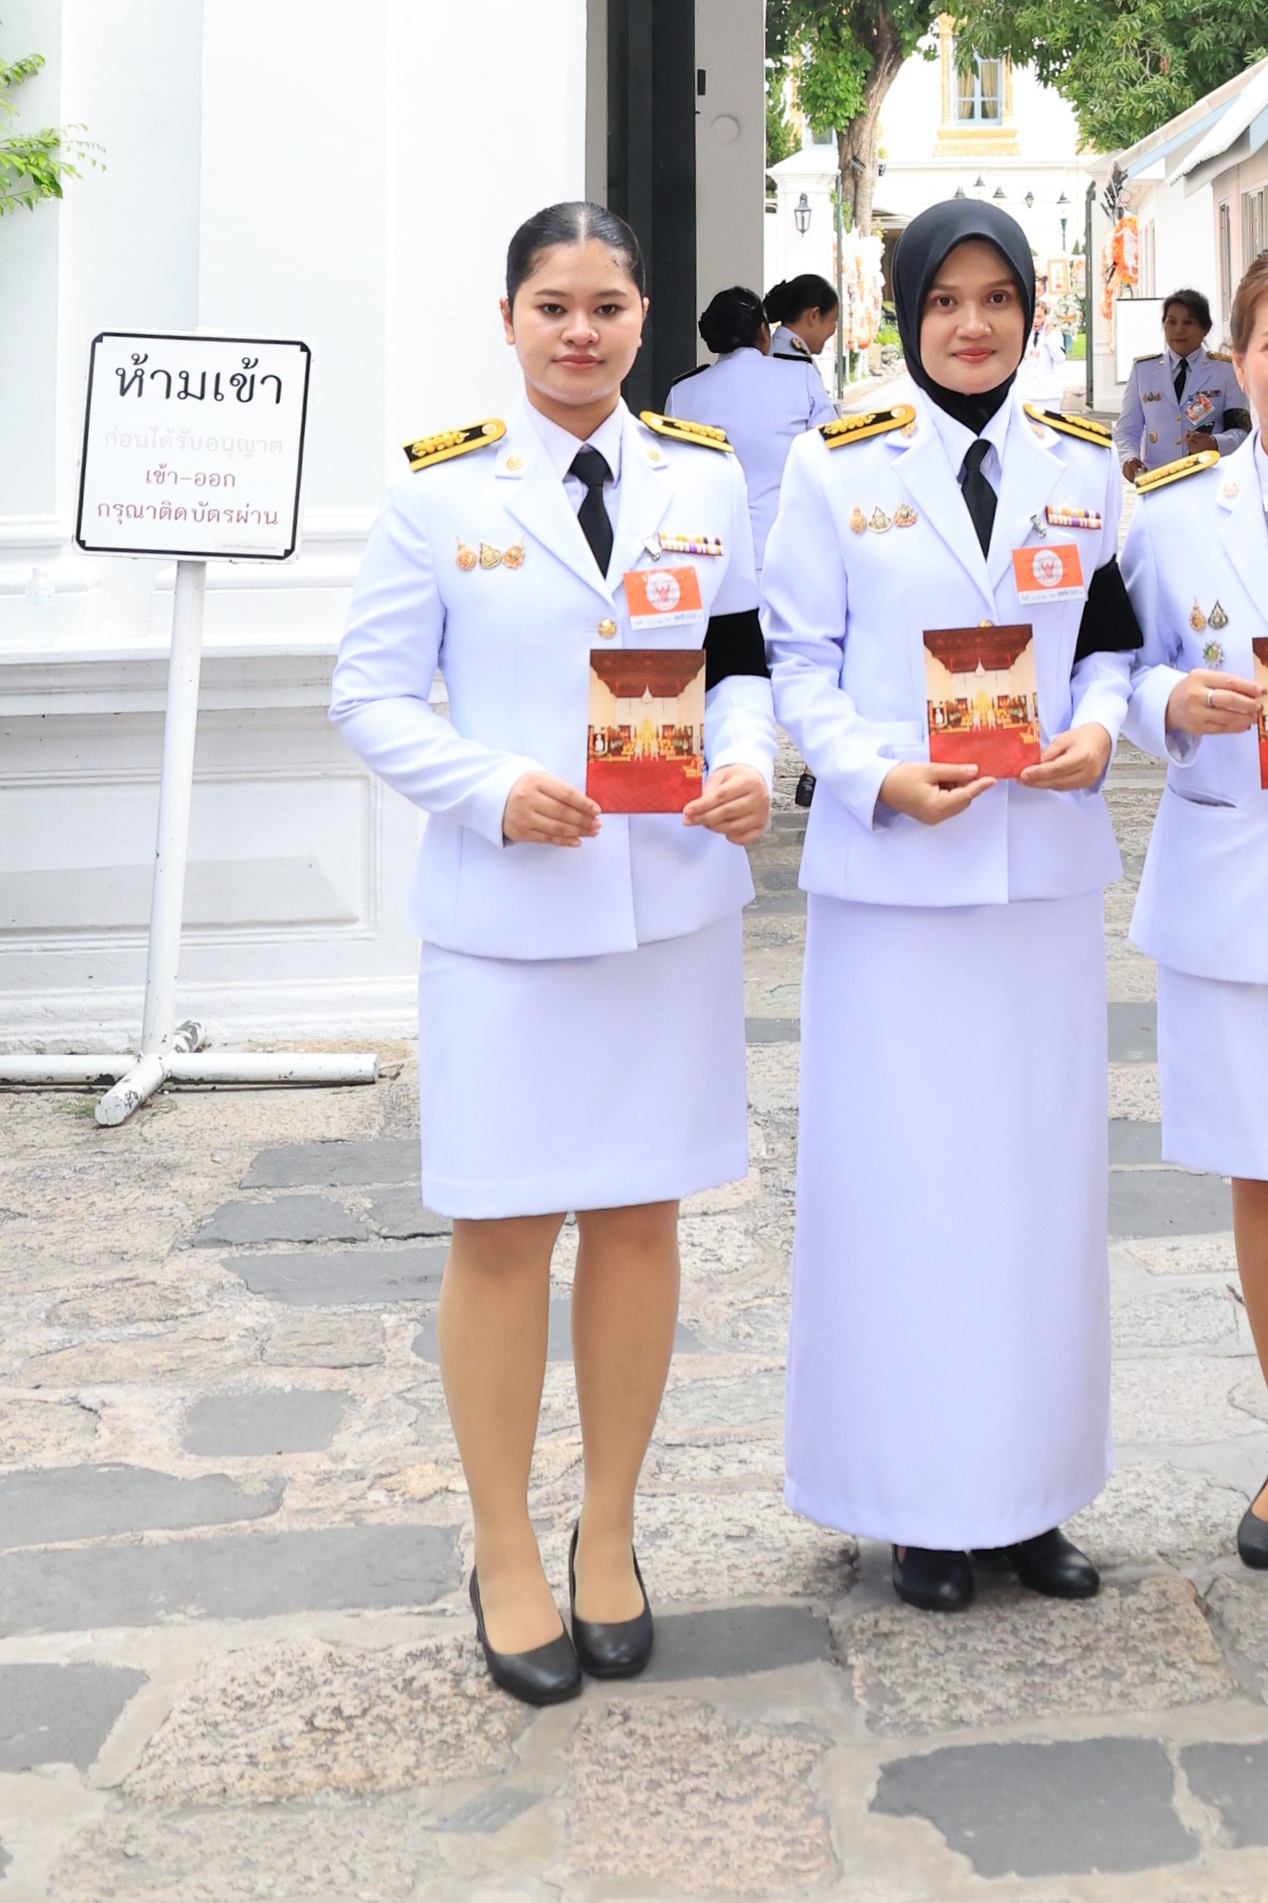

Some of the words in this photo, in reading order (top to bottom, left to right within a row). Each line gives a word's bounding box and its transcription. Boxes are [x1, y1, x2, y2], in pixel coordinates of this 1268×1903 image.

[115, 353, 282, 404] ห้ามเข้า
[104, 425, 283, 458] ก่อนได้รับอนุญาต
[145, 463, 236, 488] เข้า-ออก
